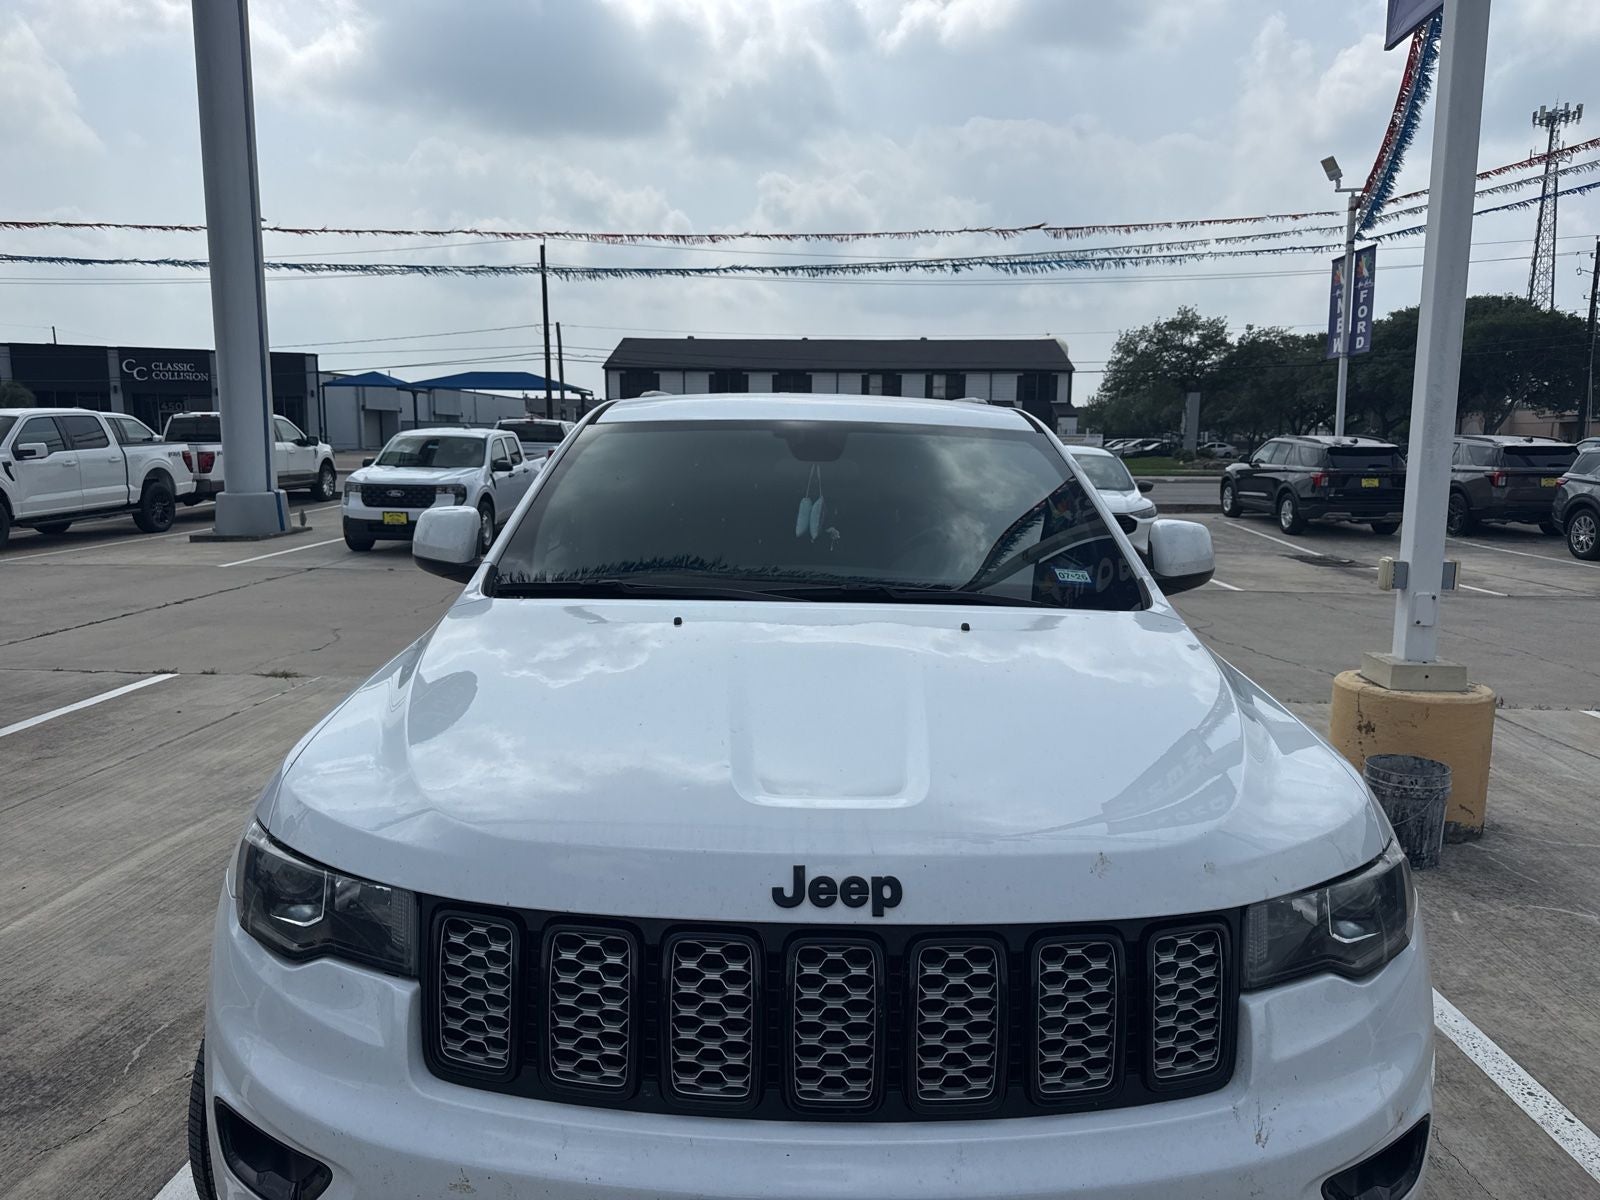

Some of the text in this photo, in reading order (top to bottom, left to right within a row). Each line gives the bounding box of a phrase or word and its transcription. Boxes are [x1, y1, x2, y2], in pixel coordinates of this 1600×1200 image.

[1355, 289, 1368, 349] FORD
[151, 362, 195, 372] CLASSIC
[152, 371, 209, 381] COLLISION
[771, 864, 903, 917] Jeep
